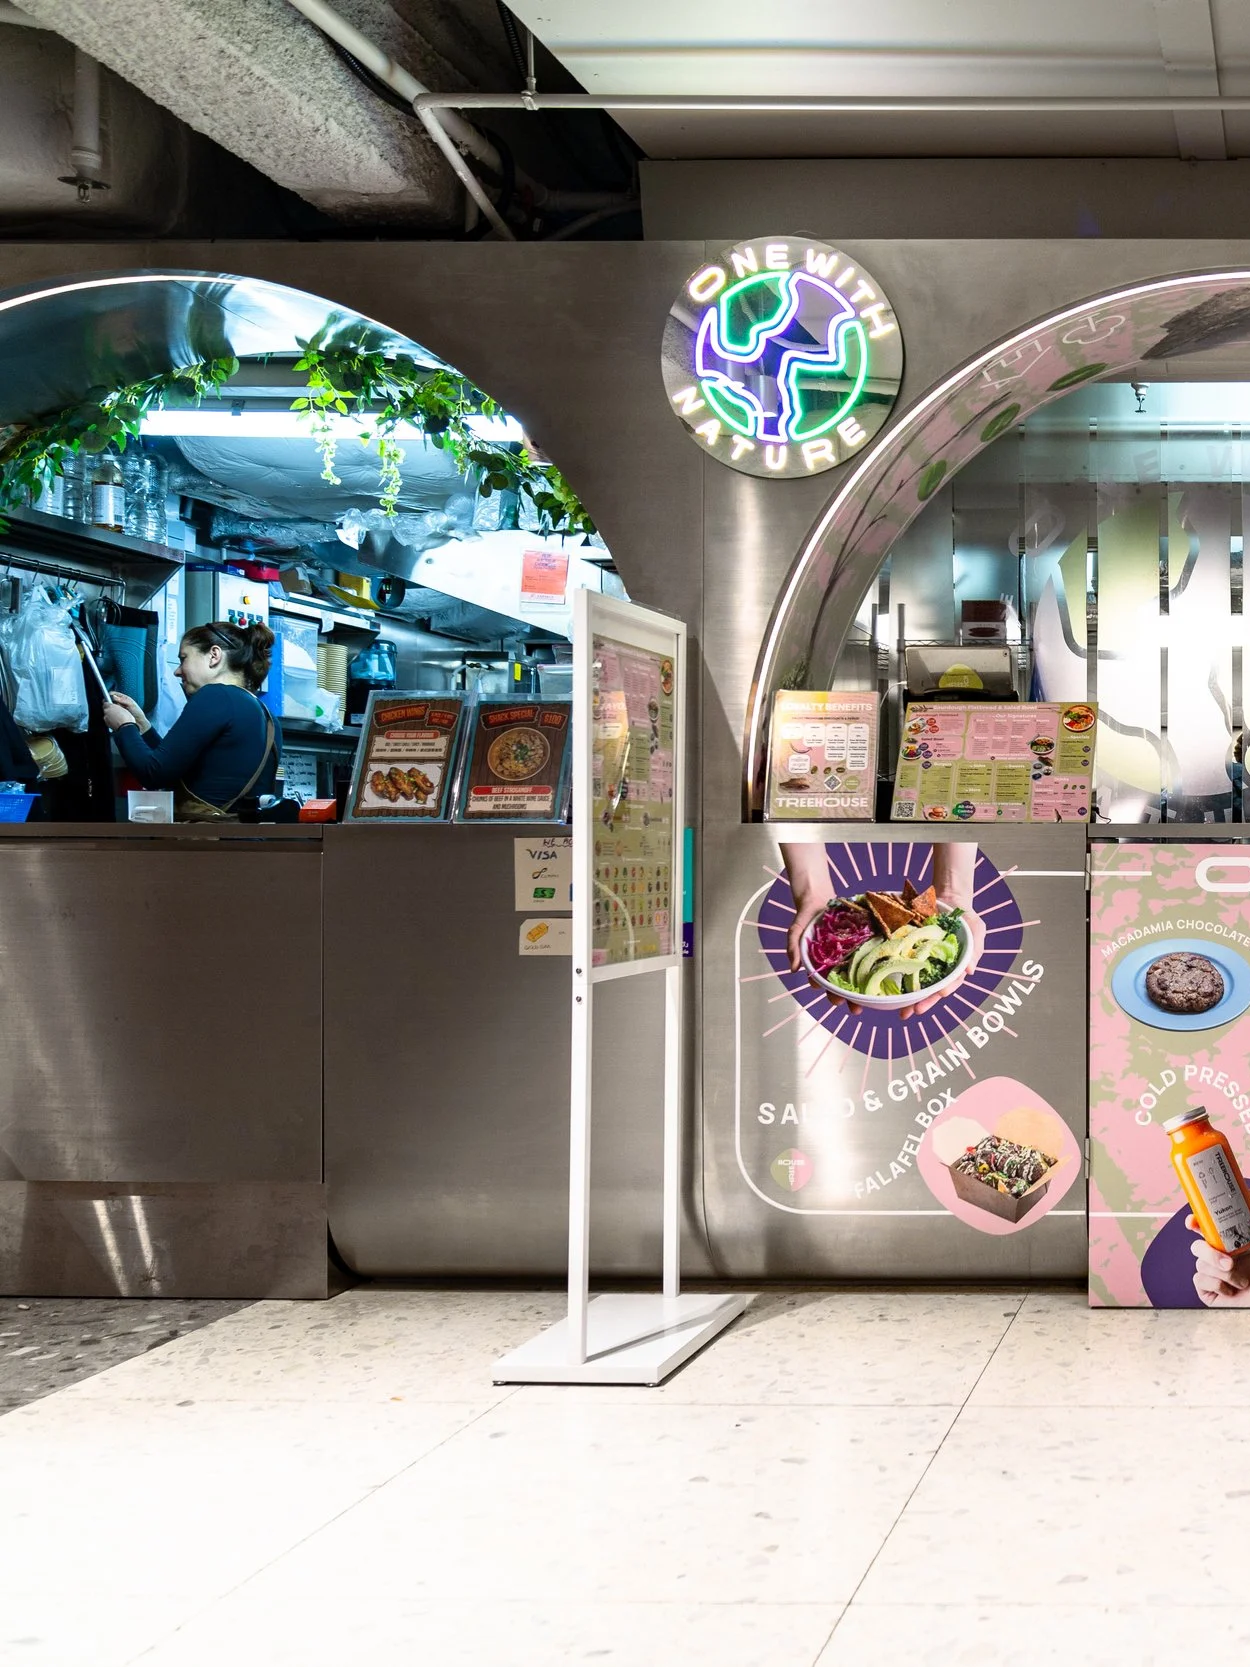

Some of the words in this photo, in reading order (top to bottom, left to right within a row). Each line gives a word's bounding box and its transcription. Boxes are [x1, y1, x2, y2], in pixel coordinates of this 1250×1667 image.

[689, 244, 789, 302] ONE
[806, 248, 895, 338] WITH
[672, 386, 866, 470] NATURE
[509, 709, 533, 720] SPECIAL
[544, 714, 562, 724] $100
[826, 702, 873, 711] BENEFITS
[775, 797, 869, 808] TREEHOUSE
[526, 848, 558, 860] VISA
[1100, 919, 1174, 958] MACADAMIA
[757, 1098, 855, 1125] SALD
[862, 1089, 883, 1112] &
[887, 1040, 971, 1103] GRAIN
[966, 958, 1045, 1050] BOWLS
[1134, 1069, 1177, 1127] COLD
[854, 1131, 926, 1200] FALAFEL
[914, 1087, 958, 1130] BOX
[1215, 1151, 1237, 1194] TREEHOUSE
[1214, 1204, 1234, 1216] Yukon
